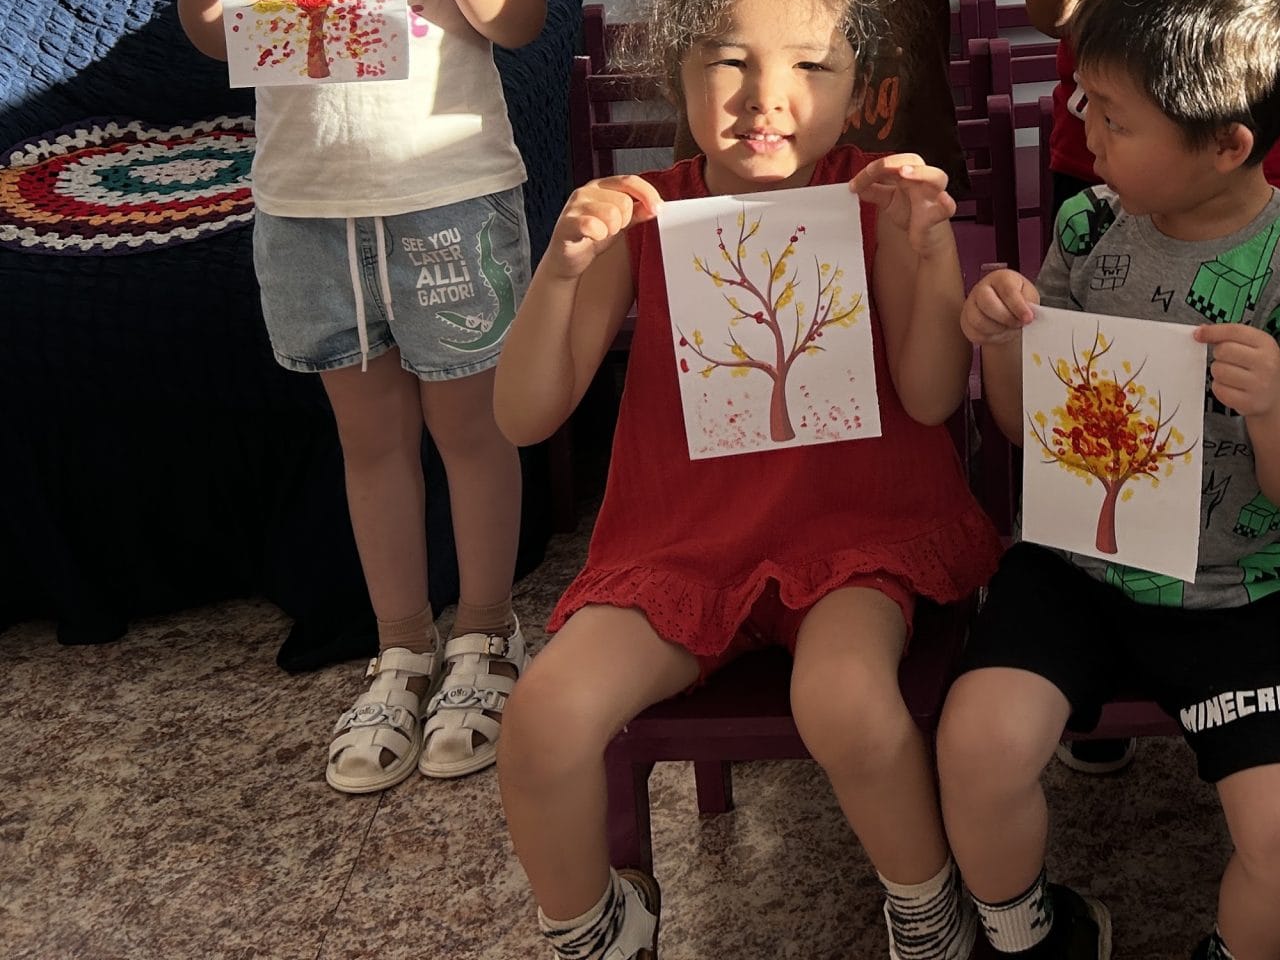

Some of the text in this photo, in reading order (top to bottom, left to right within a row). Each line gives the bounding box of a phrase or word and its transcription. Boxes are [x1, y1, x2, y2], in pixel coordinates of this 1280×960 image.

[401, 227, 461, 252] SEE YOU
[409, 245, 464, 267] LATER
[417, 282, 475, 306] GATOR!
